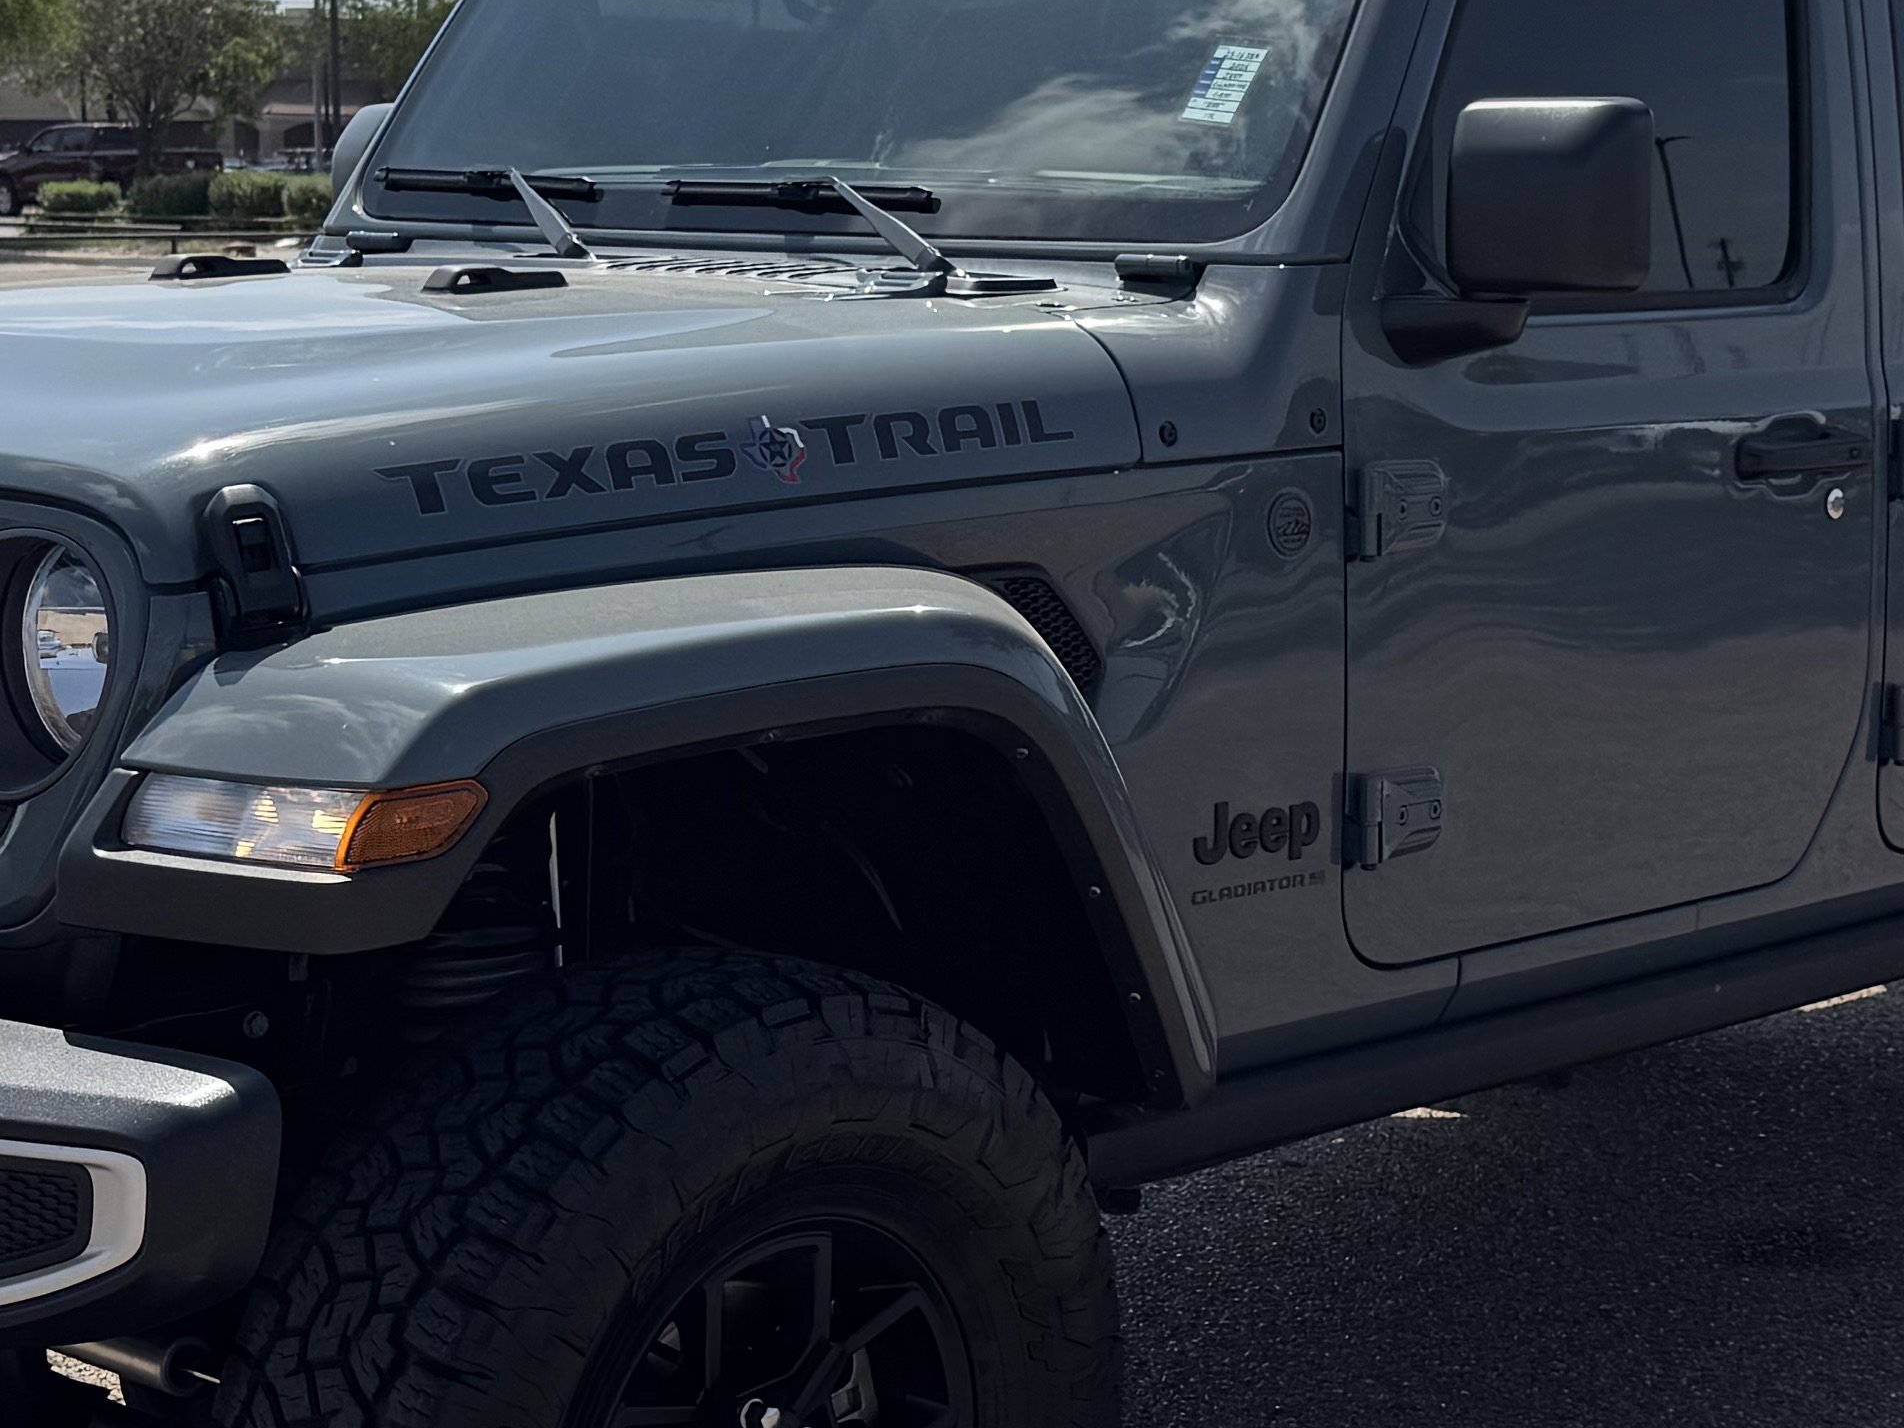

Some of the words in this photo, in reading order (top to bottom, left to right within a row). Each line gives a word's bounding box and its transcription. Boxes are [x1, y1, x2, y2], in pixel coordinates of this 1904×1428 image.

[372, 432, 737, 517] TEXAS
[800, 398, 1077, 467] TRAIL
[1193, 801, 1321, 866] Jeep
[1191, 873, 1306, 906] GLADIATOR
